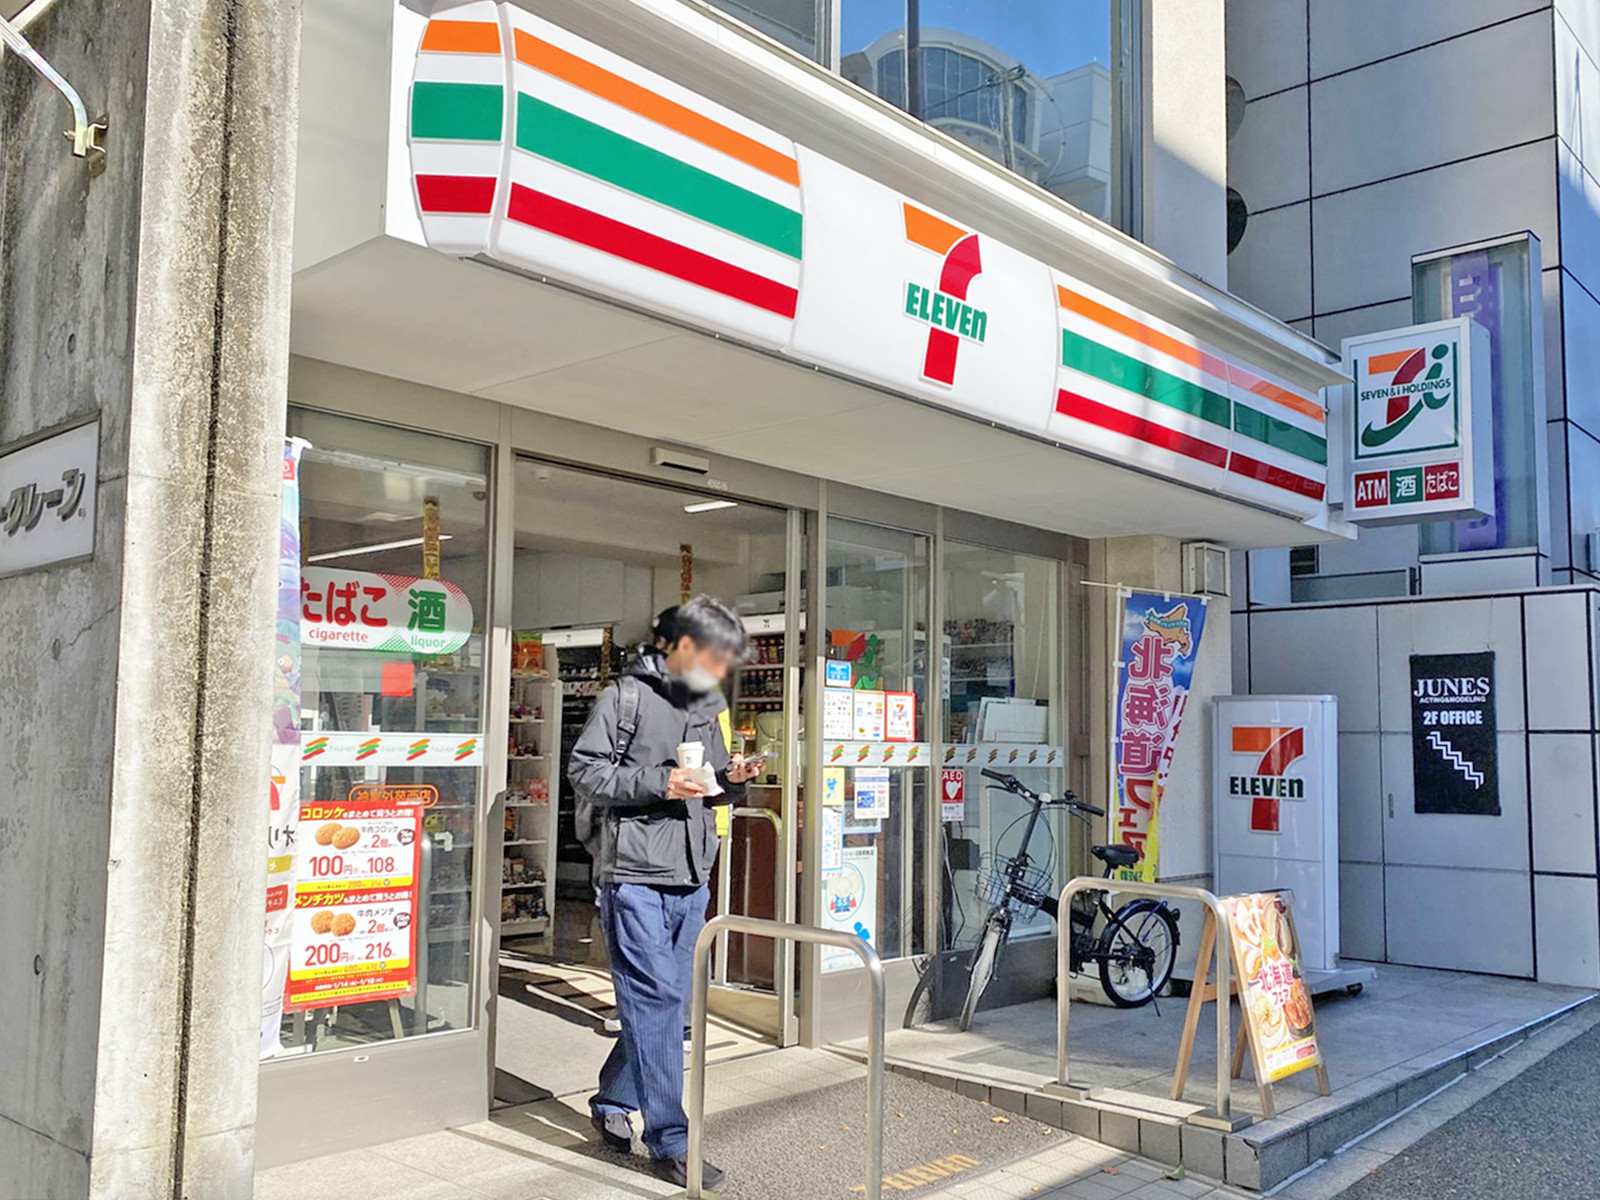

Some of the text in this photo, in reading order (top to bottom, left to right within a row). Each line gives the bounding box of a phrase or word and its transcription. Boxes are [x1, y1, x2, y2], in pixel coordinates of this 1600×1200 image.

[1402, 378, 1451, 394] HOLDINGS
[1357, 470, 1458, 501] ATM 酒 たばこ
[407, 588, 447, 634] 酒
[308, 628, 446, 649] cigarette liquor
[1413, 676, 1490, 697] JUNES
[1423, 710, 1483, 726] 2F OFFICE
[942, 771, 963, 780] AED
[367, 856, 394, 875] 108
[365, 941, 392, 960] 216
[1258, 963, 1294, 993] 北海道
